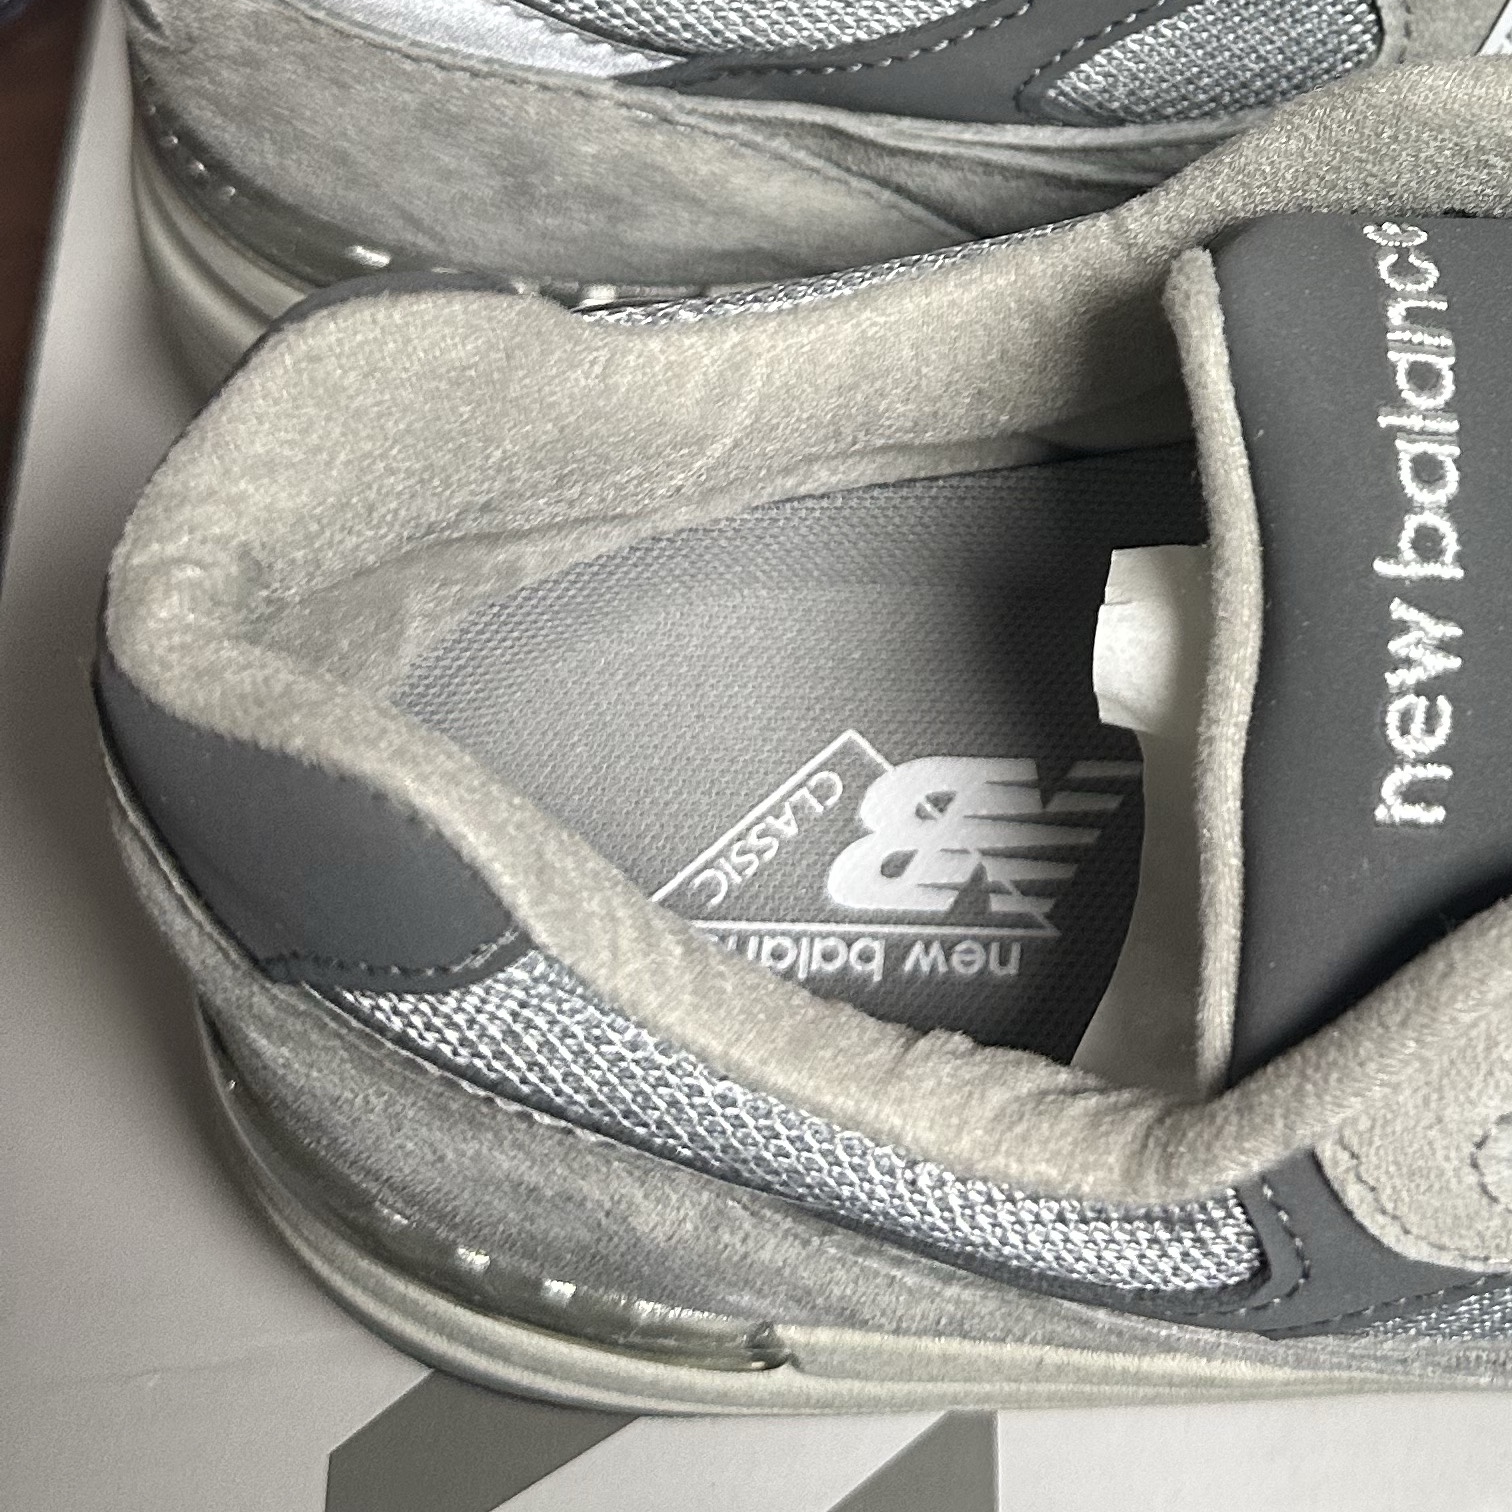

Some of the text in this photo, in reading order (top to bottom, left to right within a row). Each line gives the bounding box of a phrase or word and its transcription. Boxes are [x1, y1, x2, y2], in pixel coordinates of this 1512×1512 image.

[1362, 221, 1464, 826] new balance
[690, 769, 844, 908] CLASSIC
[706, 933, 1022, 982] new balan
